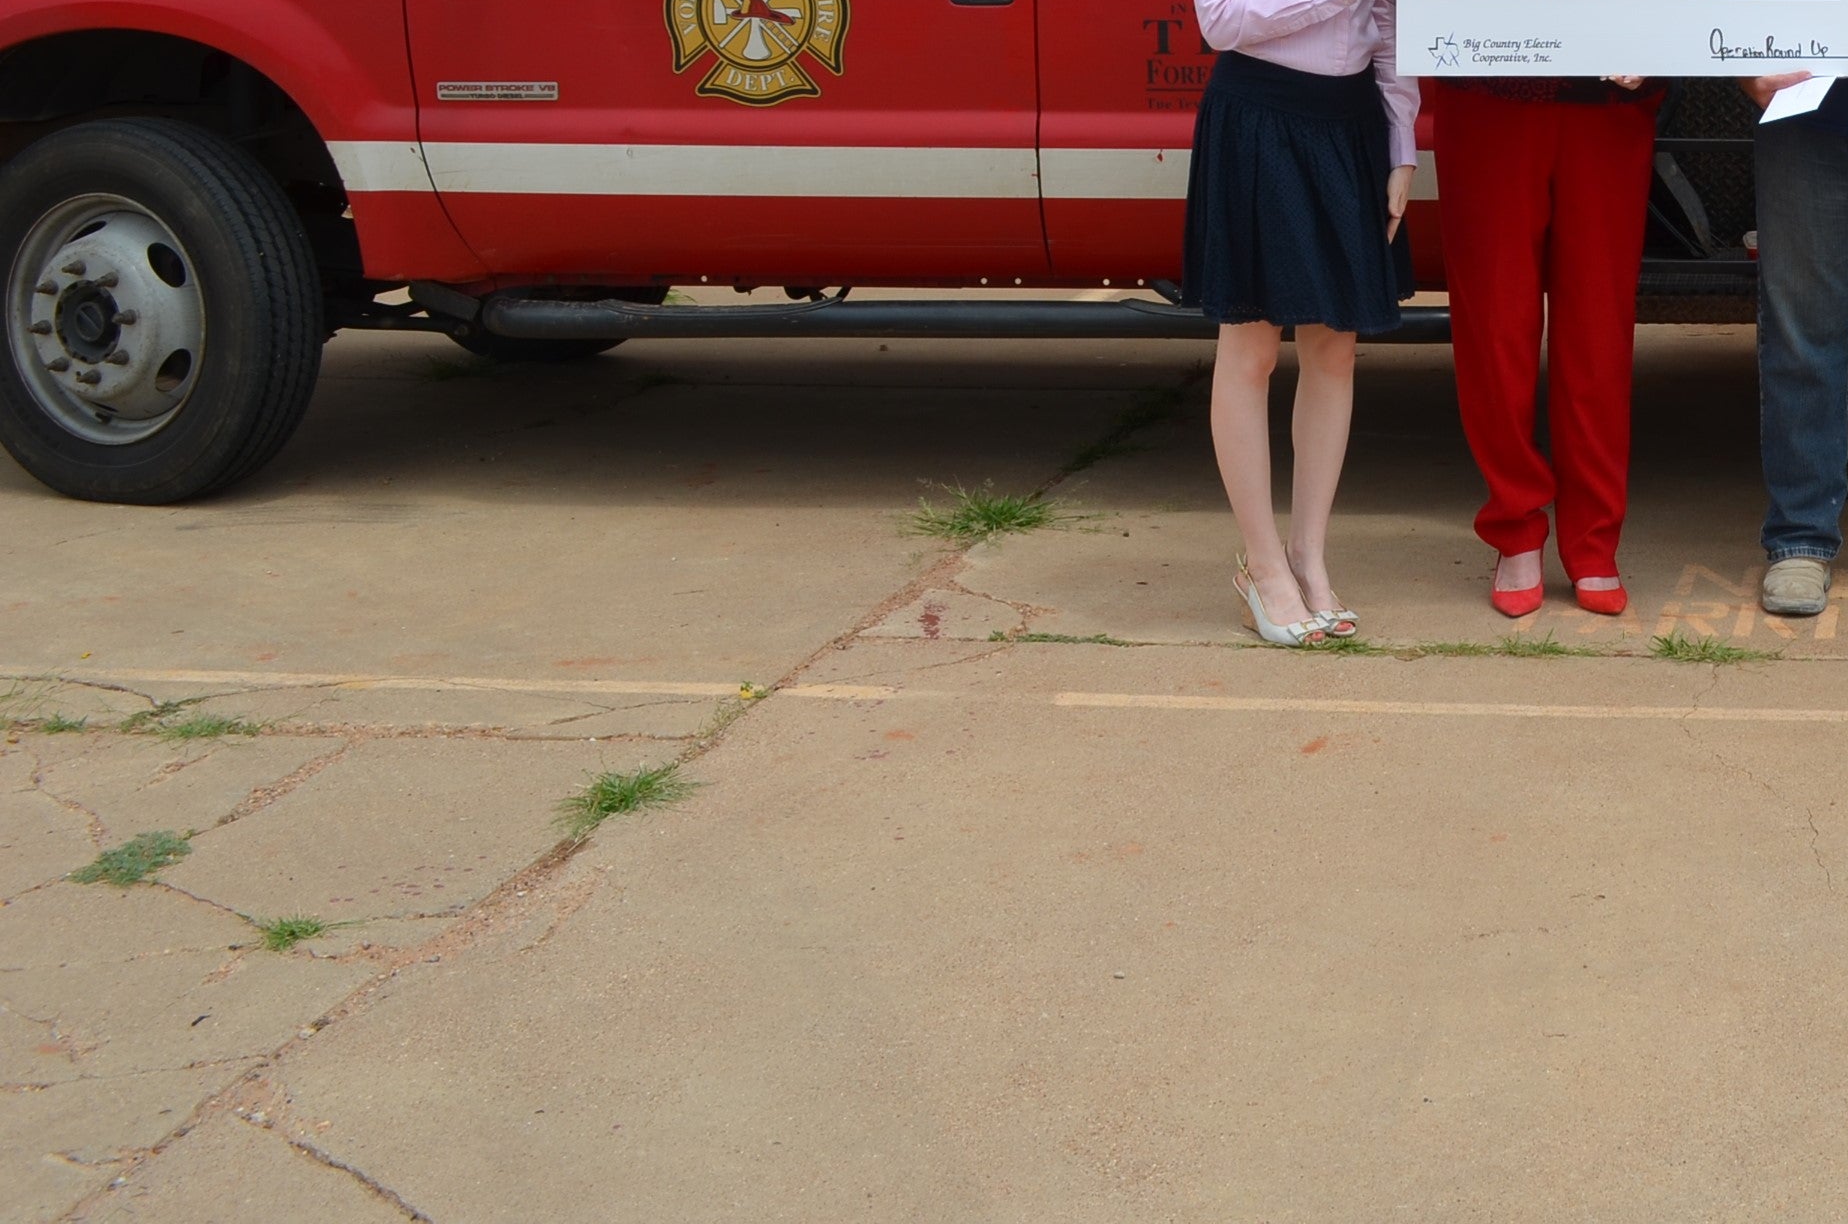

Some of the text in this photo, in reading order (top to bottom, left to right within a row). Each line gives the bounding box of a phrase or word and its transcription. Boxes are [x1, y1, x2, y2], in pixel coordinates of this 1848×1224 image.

[1463, 38, 1562, 53] Big Country Electric
[1766, 35, 1802, 59] Round
[1811, 39, 1829, 58] Up
[1472, 53, 1552, 66] Cooperative, Inc.
[439, 84, 483, 92] POWER
[485, 84, 534, 92] STROKE
[725, 69, 797, 92] DEPT.
